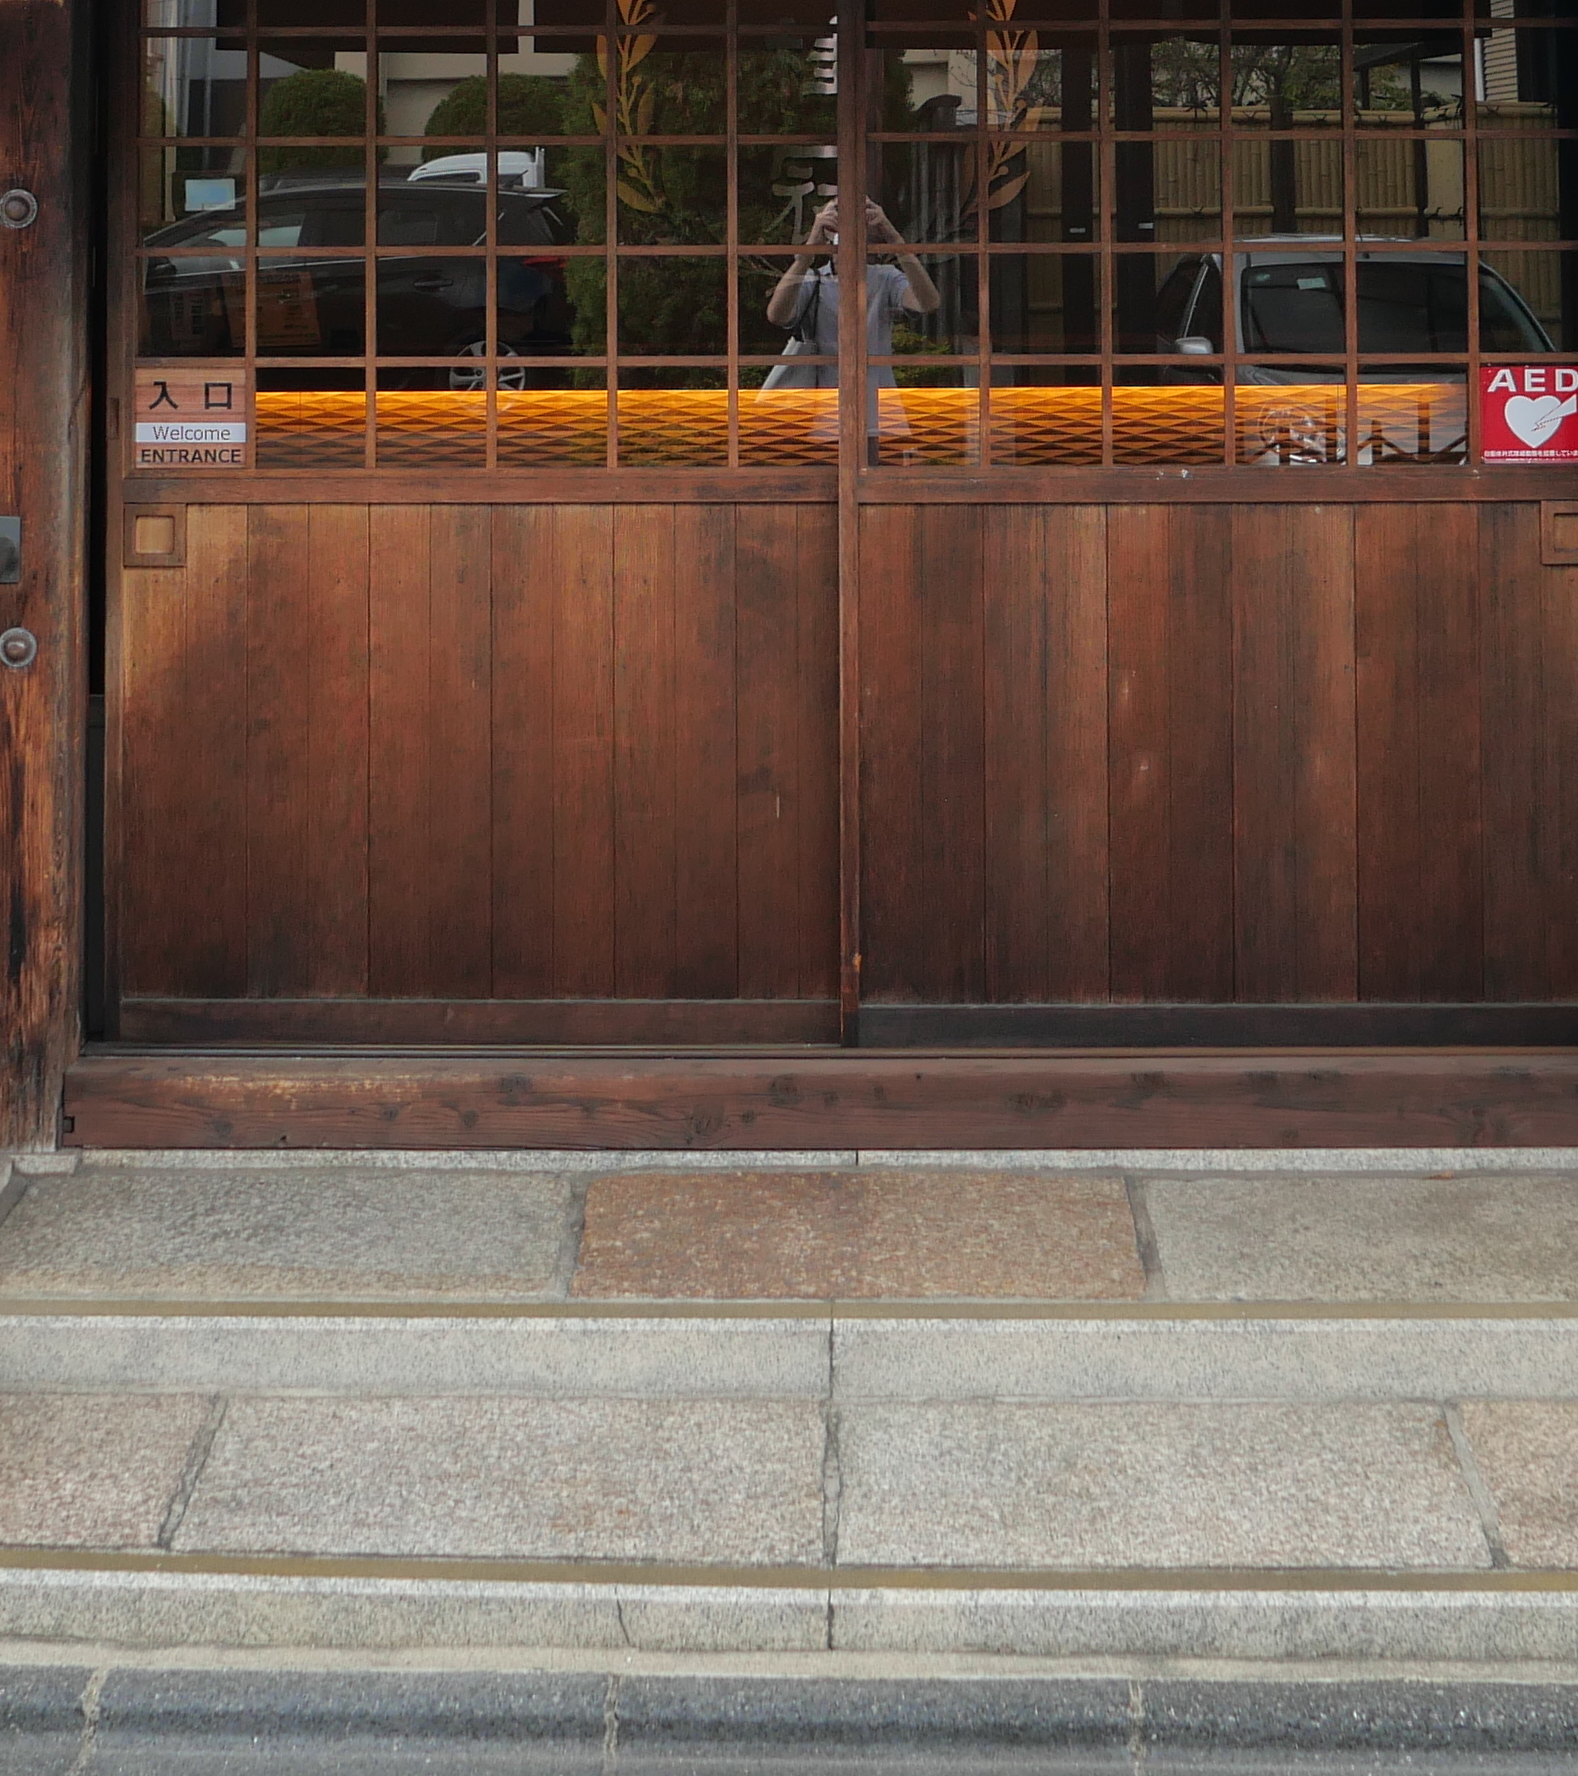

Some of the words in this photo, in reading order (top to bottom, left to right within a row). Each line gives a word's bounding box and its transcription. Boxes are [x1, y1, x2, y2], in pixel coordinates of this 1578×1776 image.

[148, 380, 233, 410] 入口
[152, 425, 231, 441] Welcome
[141, 449, 241, 463] ENTRANCE
